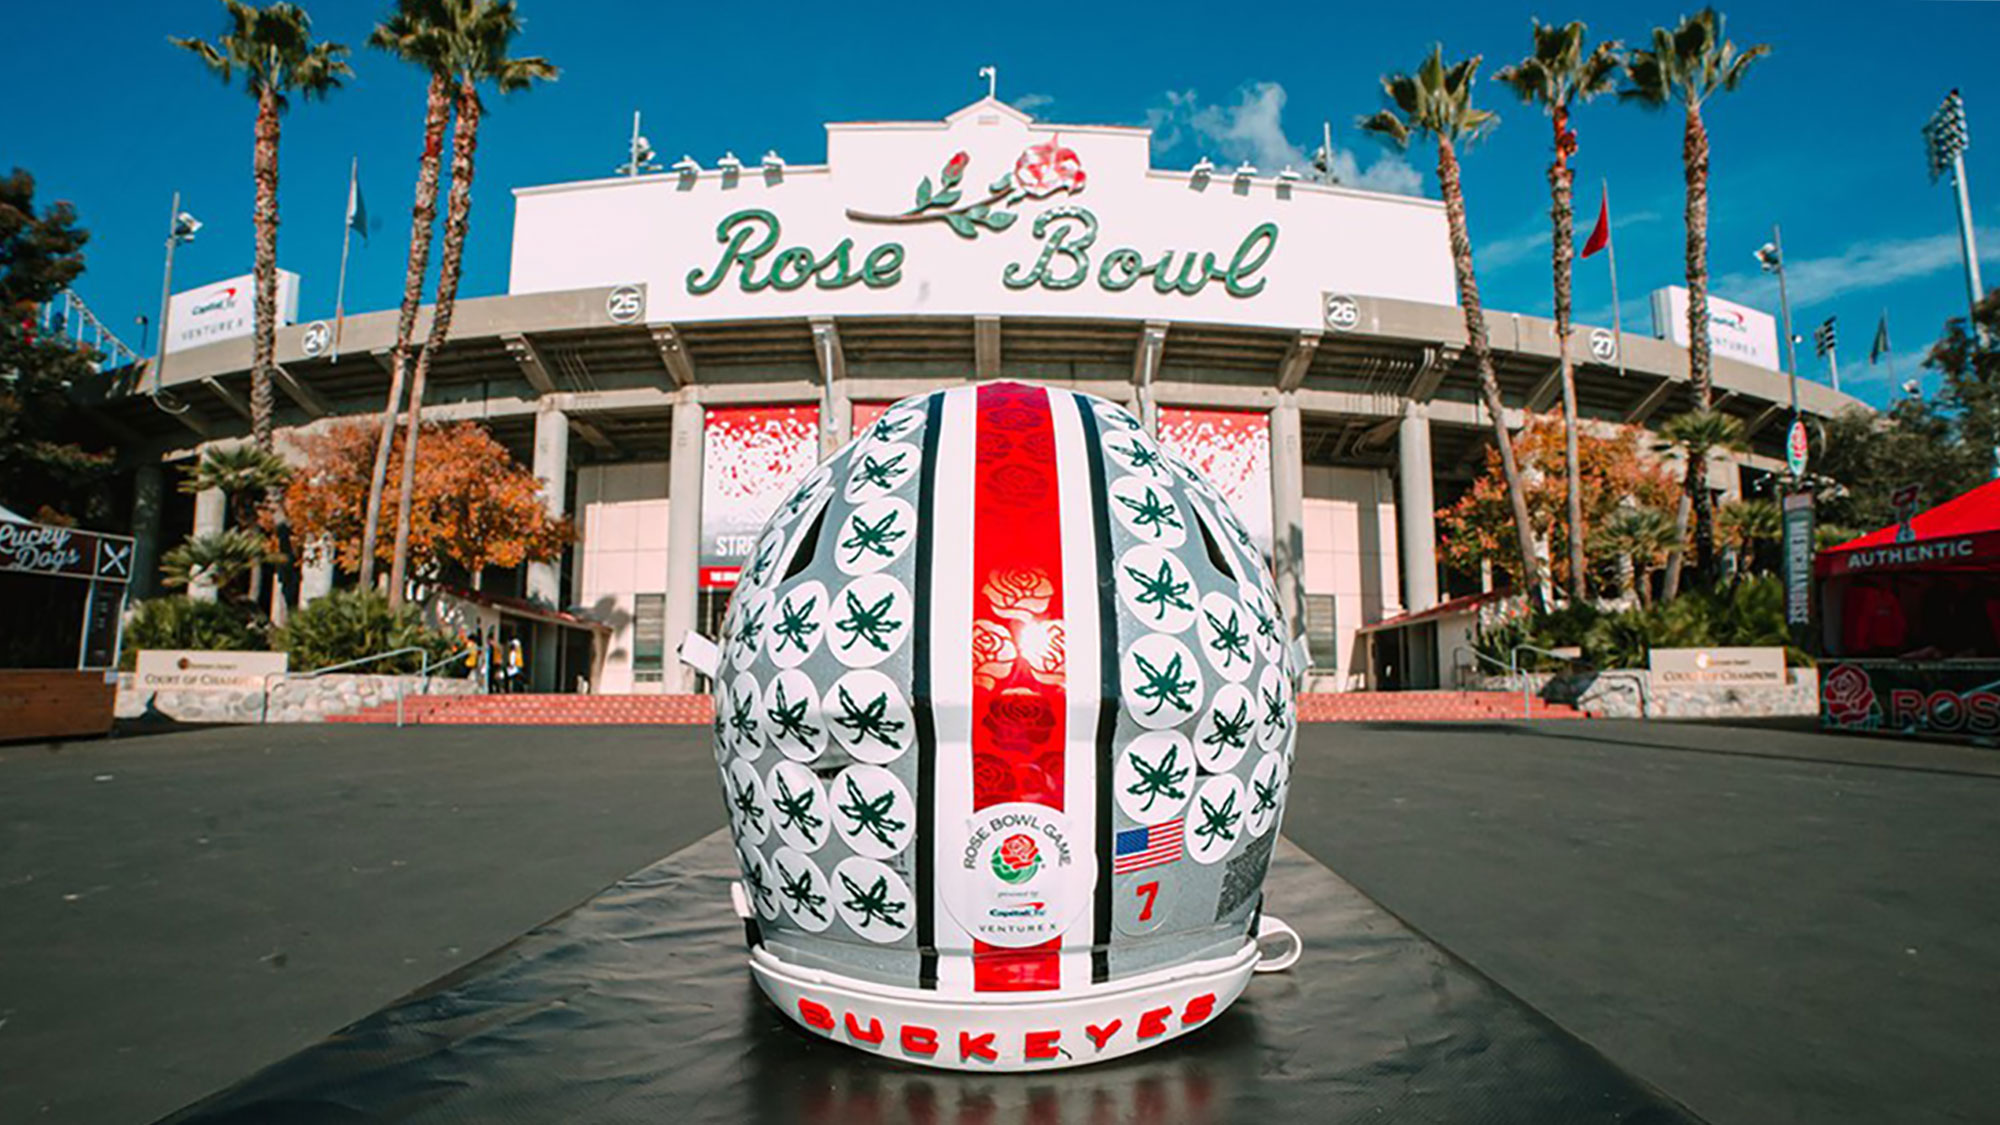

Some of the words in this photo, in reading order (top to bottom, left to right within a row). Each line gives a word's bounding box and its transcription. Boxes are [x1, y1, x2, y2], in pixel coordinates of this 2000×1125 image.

[686, 207, 906, 297] Rose
[1002, 204, 1278, 299] Bowl
[610, 293, 640, 314] 25
[1328, 301, 1356, 322] 26
[1592, 337, 1612, 356] 27
[15, 546, 81, 573] Dogs
[1848, 539, 1974, 569] AUTHENTIC
[963, 827, 991, 870] ROSE
[989, 814, 1041, 832] BOWL
[1042, 823, 1072, 867] GAME
[1136, 881, 1160, 922] 7
[979, 923, 1044, 933] VENTURE
[797, 993, 1218, 1063] BUCKEYES
